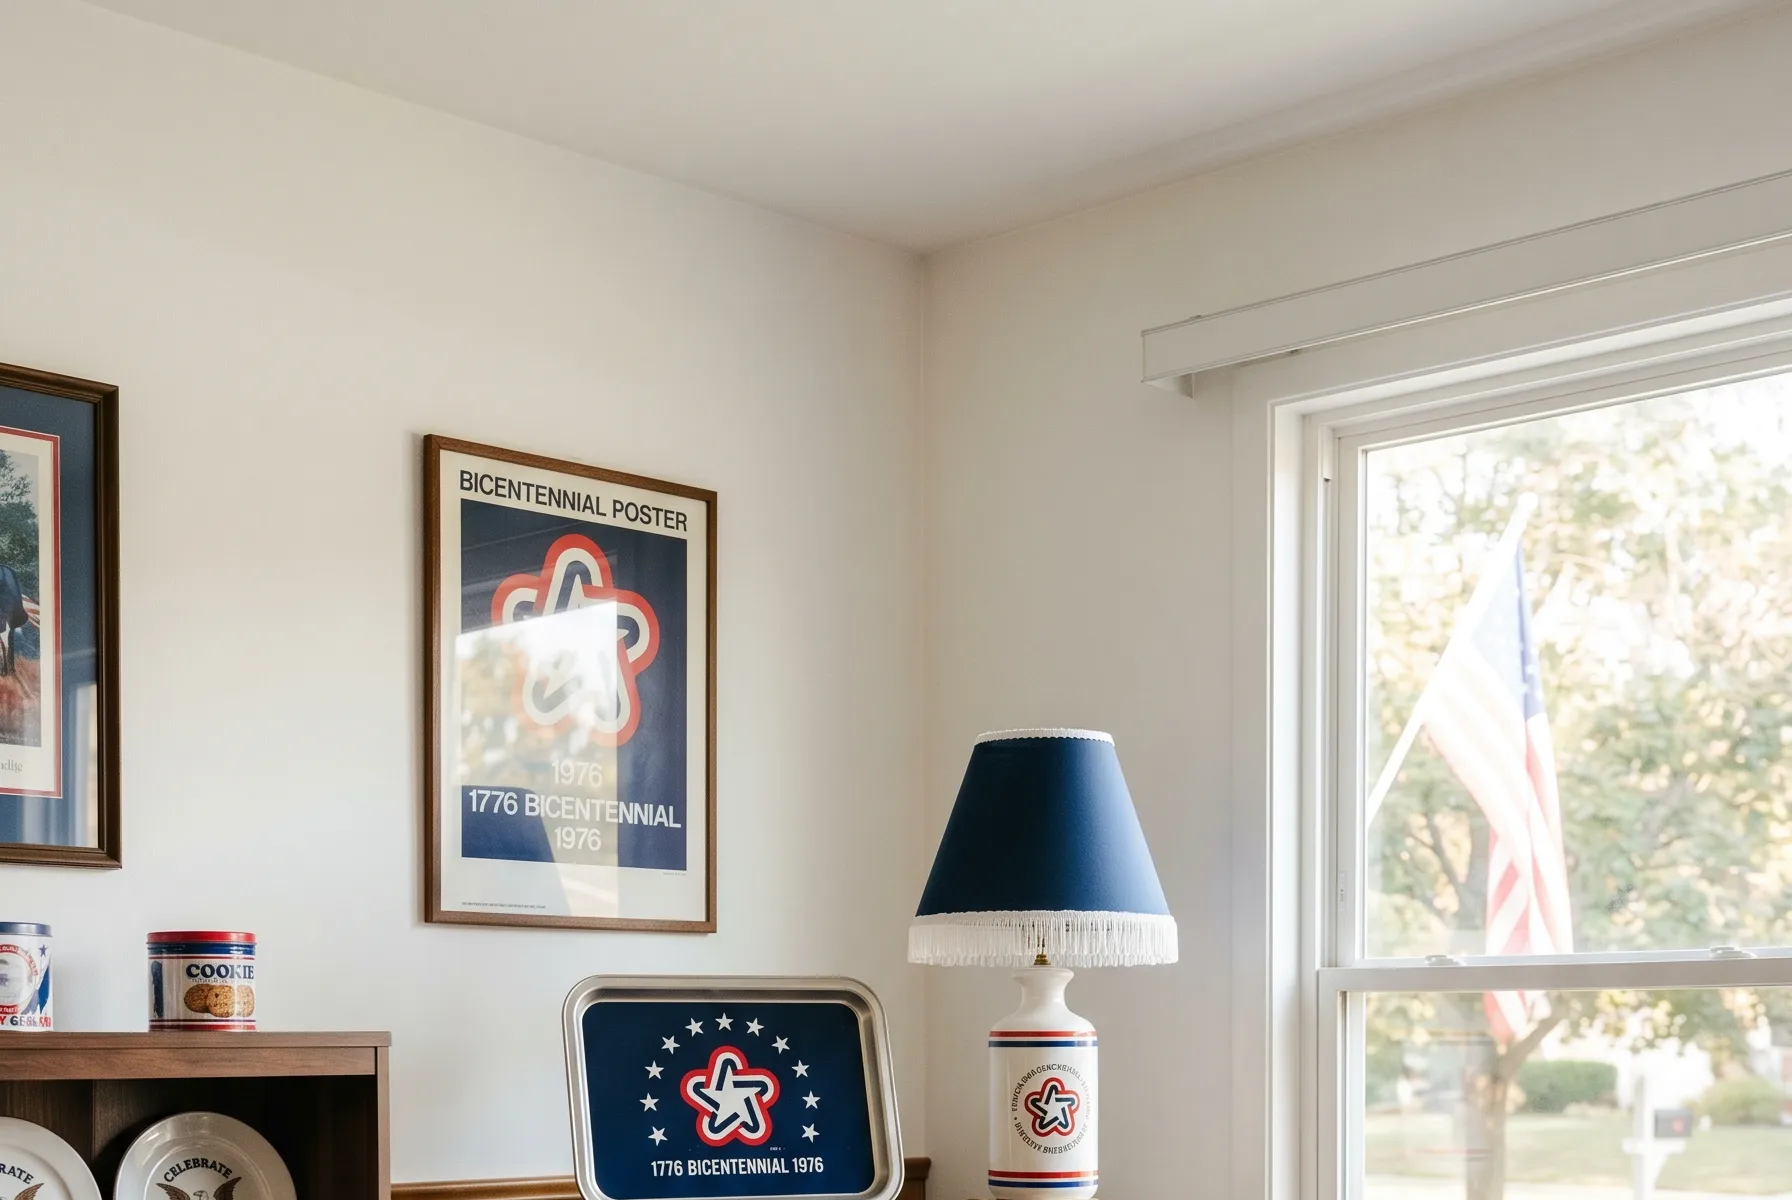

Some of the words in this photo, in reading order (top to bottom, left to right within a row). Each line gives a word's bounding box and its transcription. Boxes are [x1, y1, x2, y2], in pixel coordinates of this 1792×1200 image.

[460, 469, 607, 517] BICENTENNIAL
[612, 499, 688, 532] POSTER
[551, 760, 604, 788] 1976
[468, 789, 518, 816] 1776
[525, 793, 681, 829] BICENTENNIAL
[554, 826, 602, 851] 1976
[185, 963, 255, 980] COOKIE
[162, 1156, 234, 1183] CELEBRATE
[650, 1159, 683, 1177] 1776
[688, 1157, 790, 1176] BICENTENNIAL
[792, 1156, 824, 1174] 1976
